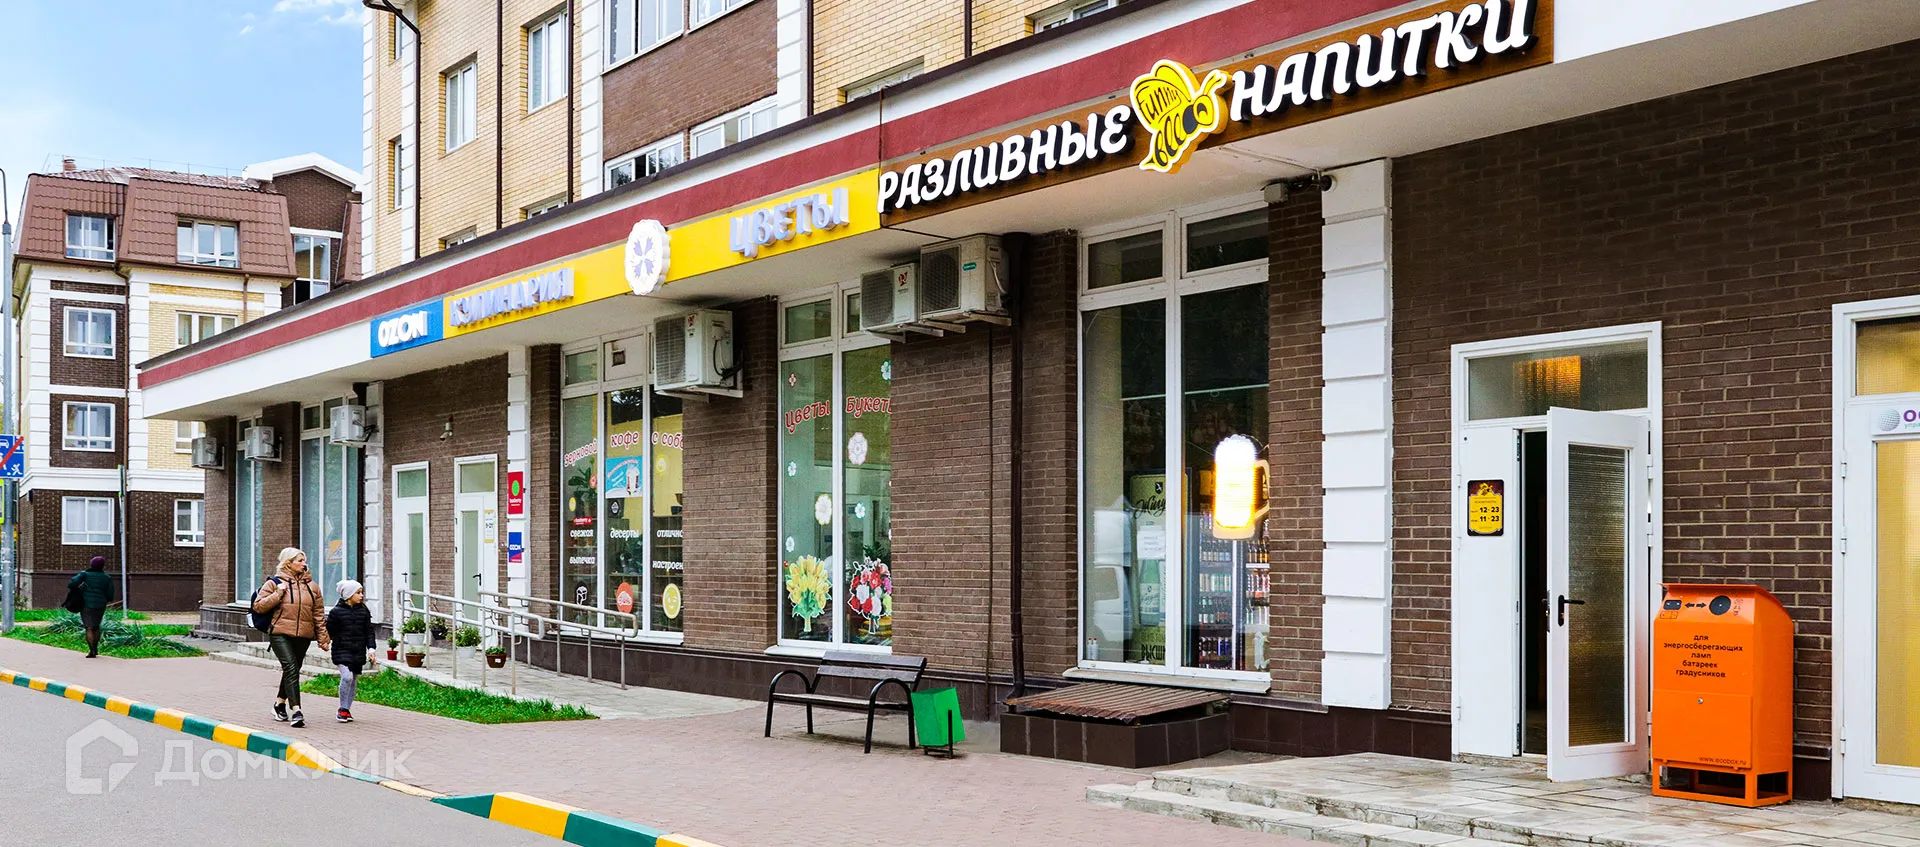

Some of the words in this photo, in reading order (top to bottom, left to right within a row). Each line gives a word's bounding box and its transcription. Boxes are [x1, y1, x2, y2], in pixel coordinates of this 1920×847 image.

[877, 104, 1131, 214] РАЗЛИВНЫЕ
[1230, 0, 1537, 122] НАПИТКИ
[730, 187, 850, 258] ЦВЕТЫ
[449, 267, 574, 327] КУЛИНАРИЯ
[377, 310, 428, 348] OZON
[610, 431, 639, 450] кофе
[610, 527, 640, 541] десерты
[1663, 642, 1743, 652] энергосберегающих
[1675, 669, 1726, 678] градусников
[1682, 660, 1717, 668] батареек
